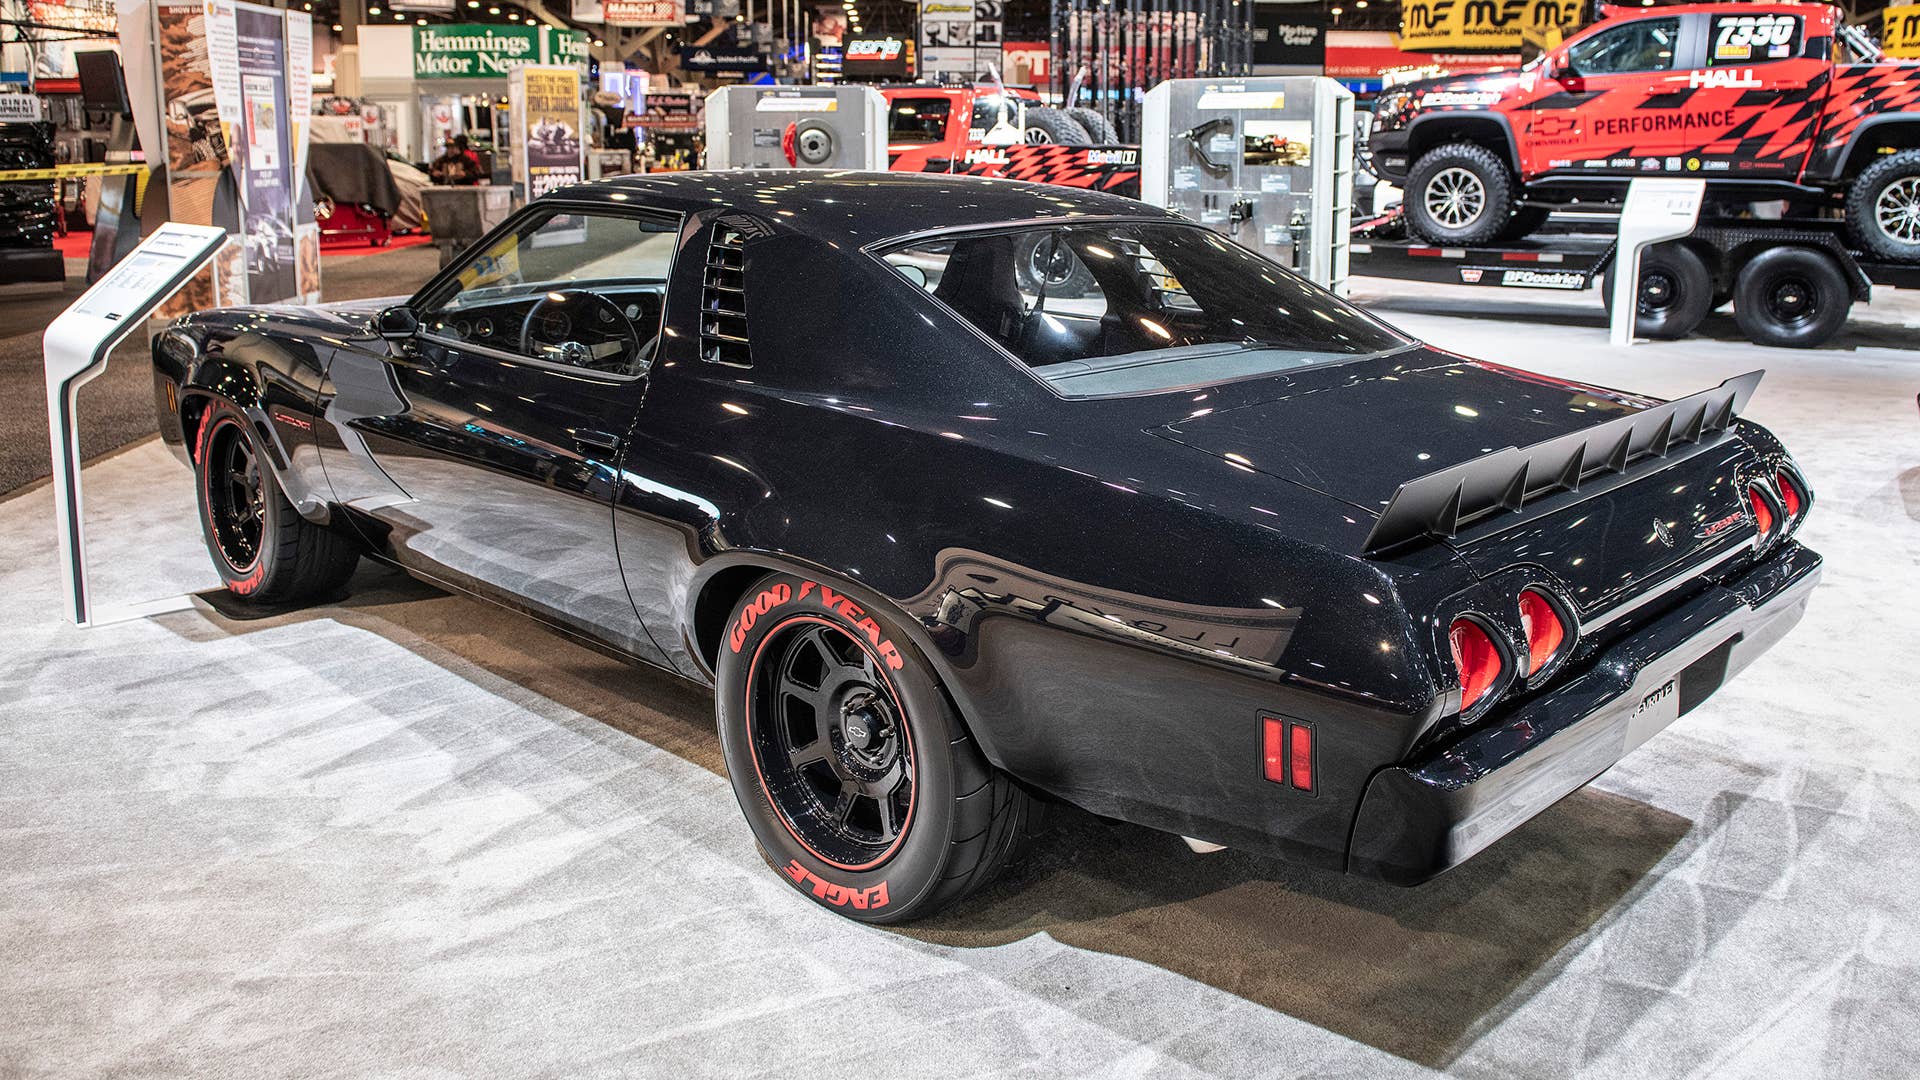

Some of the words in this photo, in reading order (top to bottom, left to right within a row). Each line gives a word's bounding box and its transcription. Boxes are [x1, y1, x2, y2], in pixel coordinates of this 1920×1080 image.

[608, 2, 654, 13] MARCH
[1279, 24, 1318, 37] Motive
[1283, 35, 1314, 46] Gear
[1715, 16, 1795, 46] 7330
[420, 30, 530, 56] Hemmings
[416, 52, 472, 74] Motor
[1689, 69, 1763, 89] HALL
[1594, 110, 1736, 135] PERFORMANCE
[964, 149, 1010, 164] HALL
[1504, 271, 1585, 287] BFGoodrich
[730, 583, 792, 654] GOOD
[819, 585, 905, 671] YEAR
[783, 859, 890, 910] EAGLE
